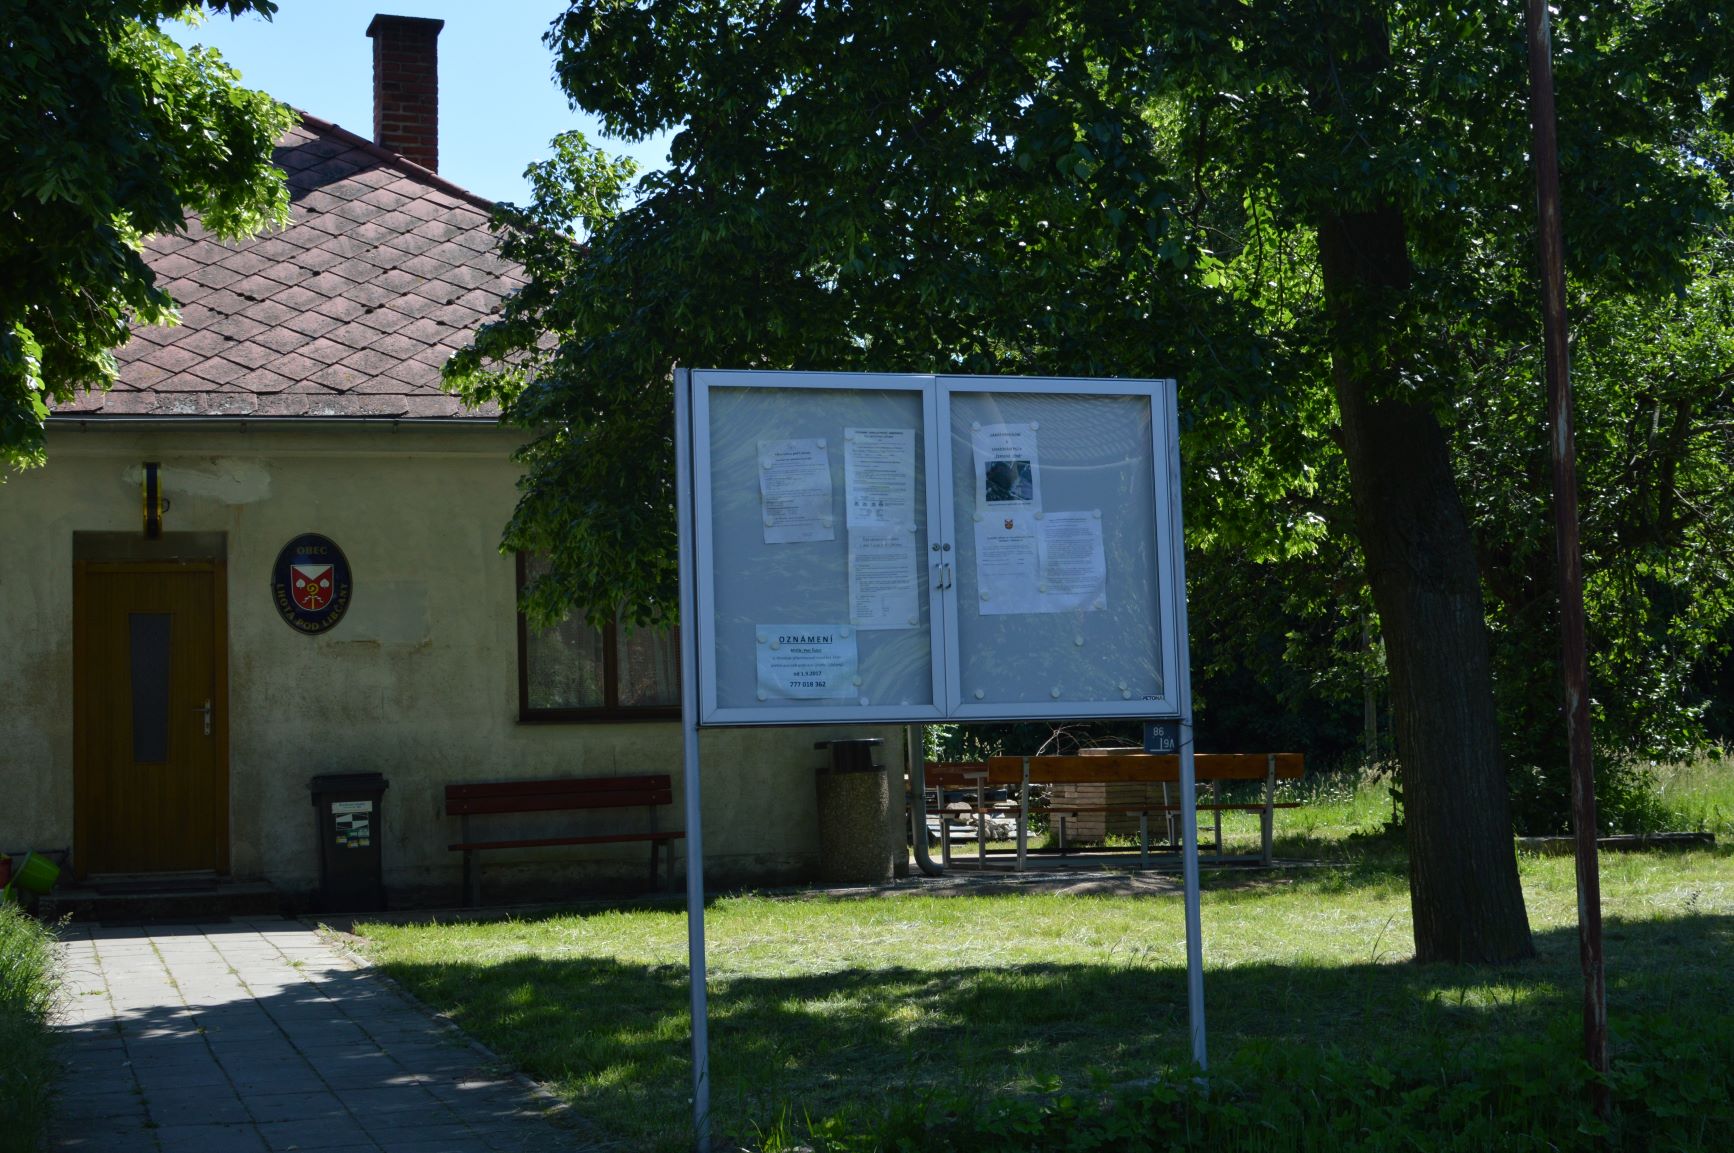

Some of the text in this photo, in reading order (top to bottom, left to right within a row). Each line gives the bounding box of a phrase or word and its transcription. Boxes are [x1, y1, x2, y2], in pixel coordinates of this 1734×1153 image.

[296, 546, 328, 555] OBEC
[295, 618, 320, 631] POD
[778, 634, 833, 643] OZNÁMENÍ
